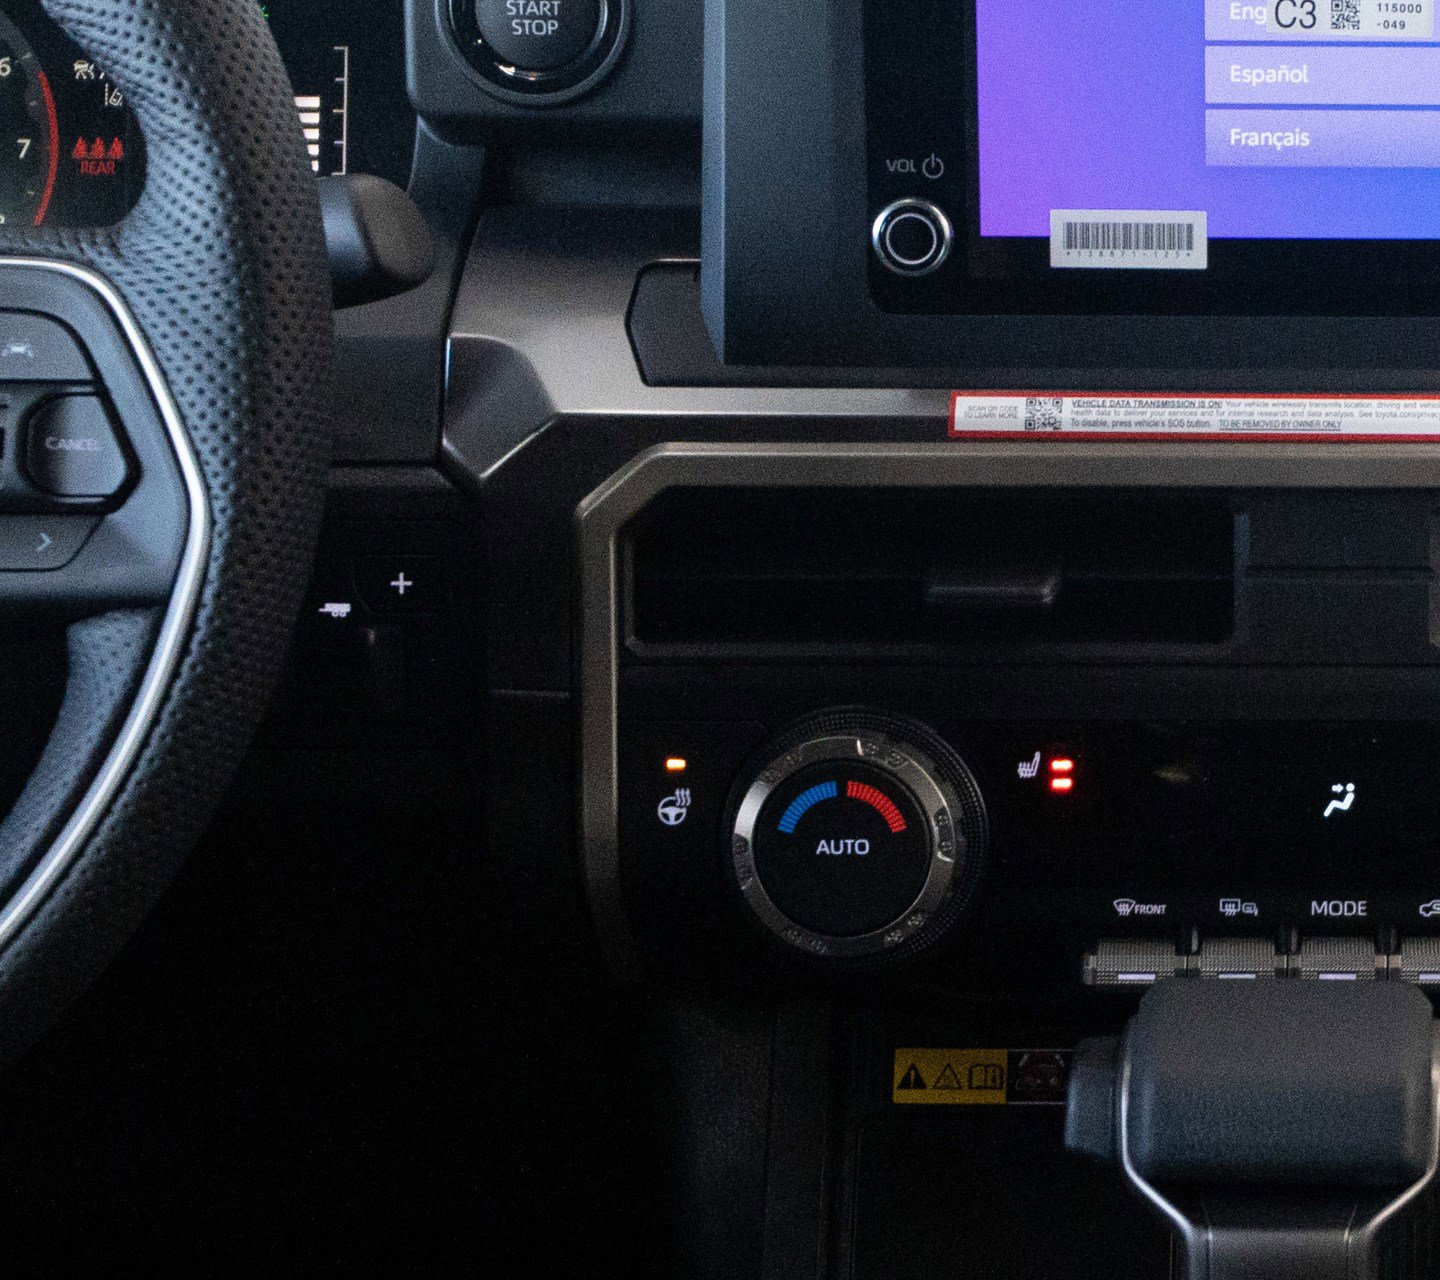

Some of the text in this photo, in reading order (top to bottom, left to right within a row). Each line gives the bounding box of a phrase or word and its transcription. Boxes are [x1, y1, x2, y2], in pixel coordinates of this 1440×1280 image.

[506, 0, 560, 16] START
[1377, 3, 1422, 13] 115000
[512, 20, 558, 36] STOP
[1376, 19, 1406, 30] -049
[1230, 65, 1308, 86] Español
[1230, 127, 1310, 150] Français
[17, 139, 32, 159] 7
[80, 161, 116, 176] REAR
[886, 159, 916, 172] VOL
[1071, 400, 1107, 408] VEHICLE
[1109, 400, 1130, 408] DATA
[1133, 400, 1196, 408] TRANSMISSION
[816, 838, 870, 857] AUTO
[1134, 903, 1167, 915] FRONT
[1310, 900, 1368, 917] MODE
